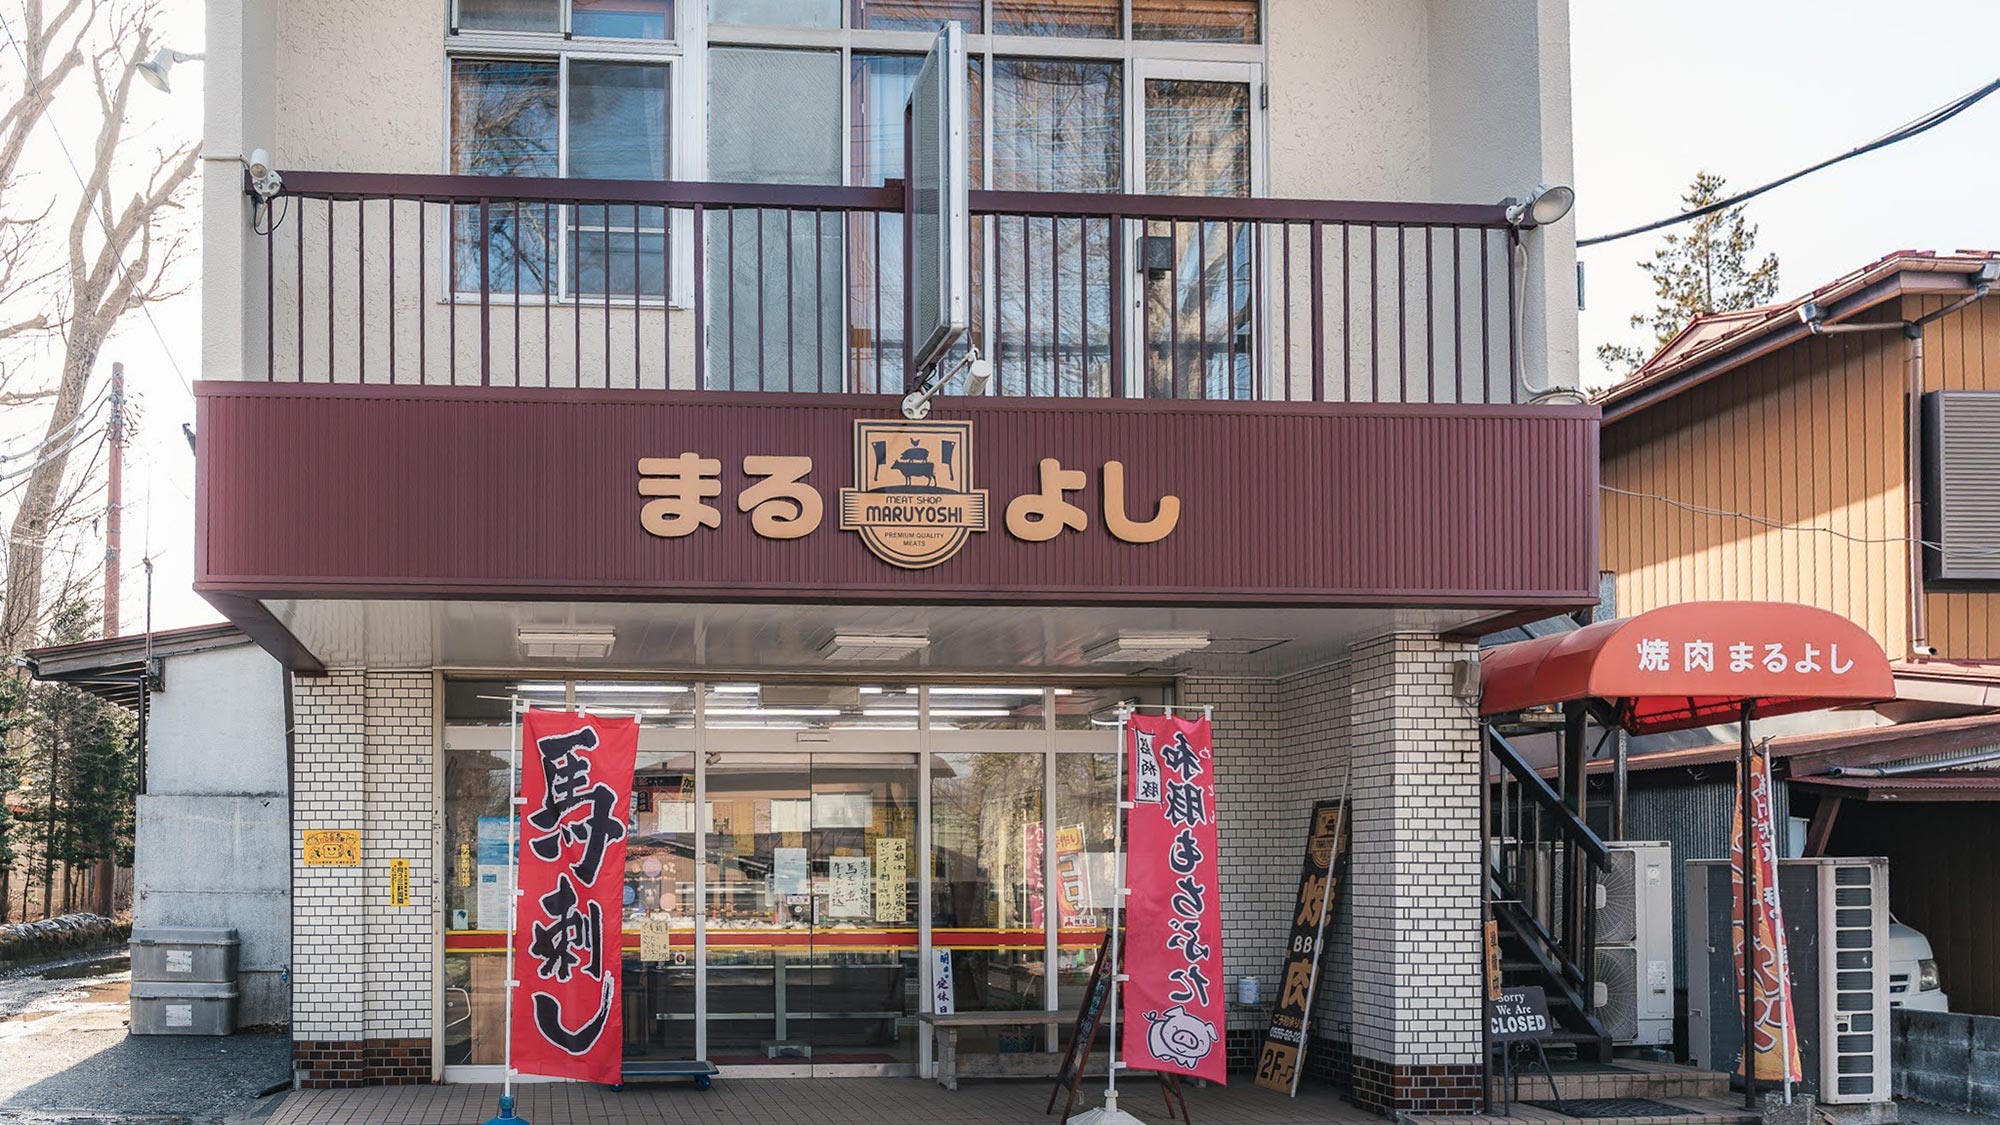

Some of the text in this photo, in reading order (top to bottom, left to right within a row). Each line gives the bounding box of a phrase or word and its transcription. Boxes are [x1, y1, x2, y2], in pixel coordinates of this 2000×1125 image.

[638, 452, 1181, 543] まる よし
[885, 495, 942, 504] MEAT SHOP
[866, 505, 962, 523] MARUYOSHI
[527, 727, 626, 1055] 馬刺し
[1498, 993, 1525, 1003] Sorry
[1496, 1004, 1531, 1015] We Are
[1491, 1014, 1546, 1034] CLOSED
[1260, 1049, 1285, 1081] 2F
